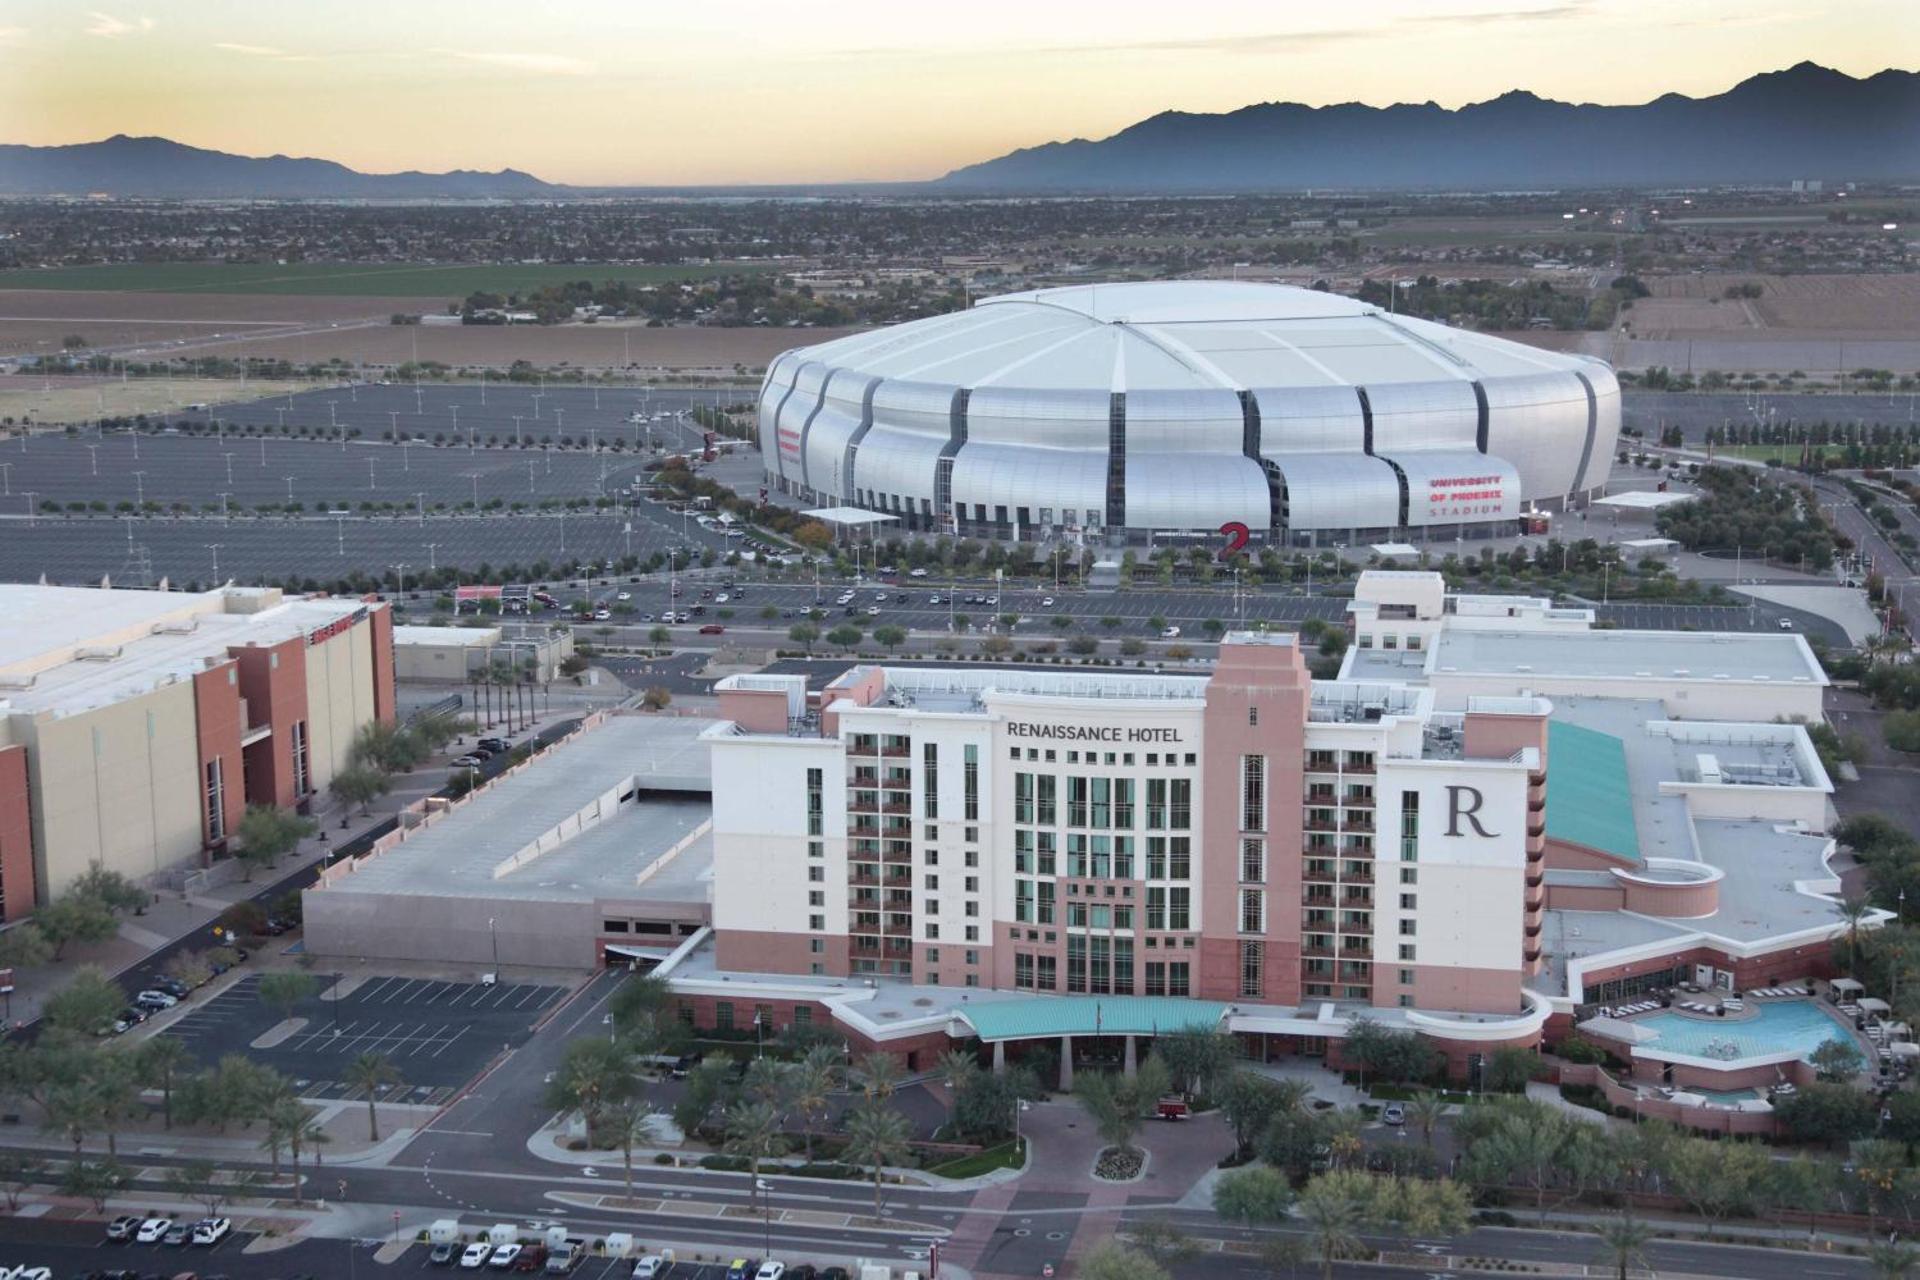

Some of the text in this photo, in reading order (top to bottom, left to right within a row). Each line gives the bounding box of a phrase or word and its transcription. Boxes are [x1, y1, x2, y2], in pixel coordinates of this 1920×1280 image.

[1430, 476, 1502, 488] UNIVERSITY
[1430, 490, 1502, 502] OF PHOENIX
[1430, 504, 1502, 517] STADIUM
[1007, 721, 1184, 742] RENAISSANCE HOTEL
[1443, 785, 1501, 838] R
